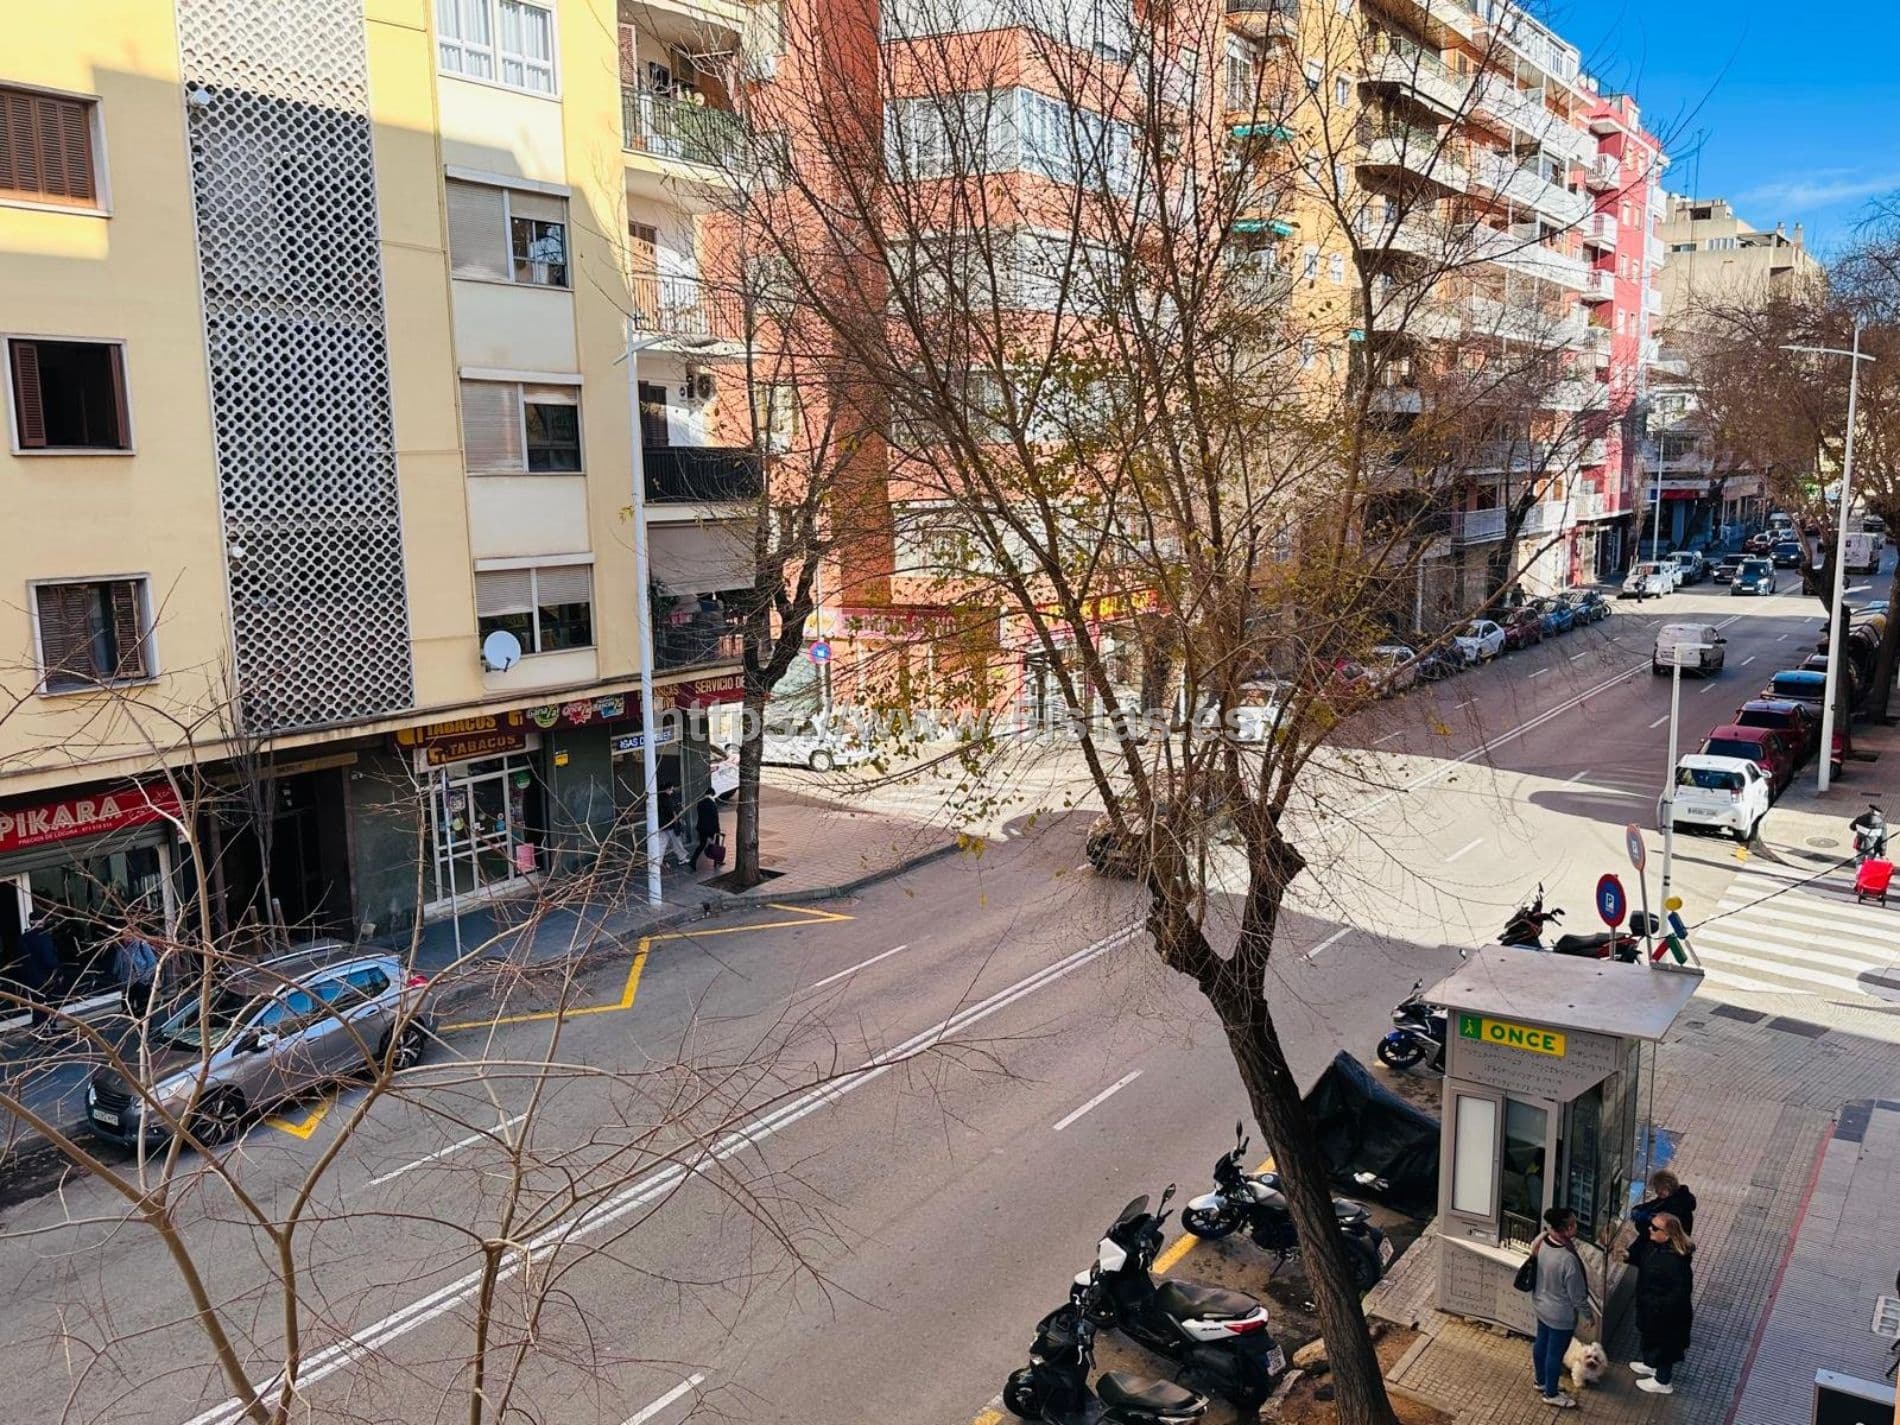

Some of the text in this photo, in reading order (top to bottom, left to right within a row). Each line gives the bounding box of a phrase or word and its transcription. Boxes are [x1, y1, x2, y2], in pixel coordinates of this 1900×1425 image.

[695, 677, 734, 695] SERVICIO
[426, 715, 497, 736] TABACOS
[450, 736, 516, 755] TABACOS
[0, 796, 123, 842] PIKARA
[1490, 1025, 1556, 1051] ONCE
